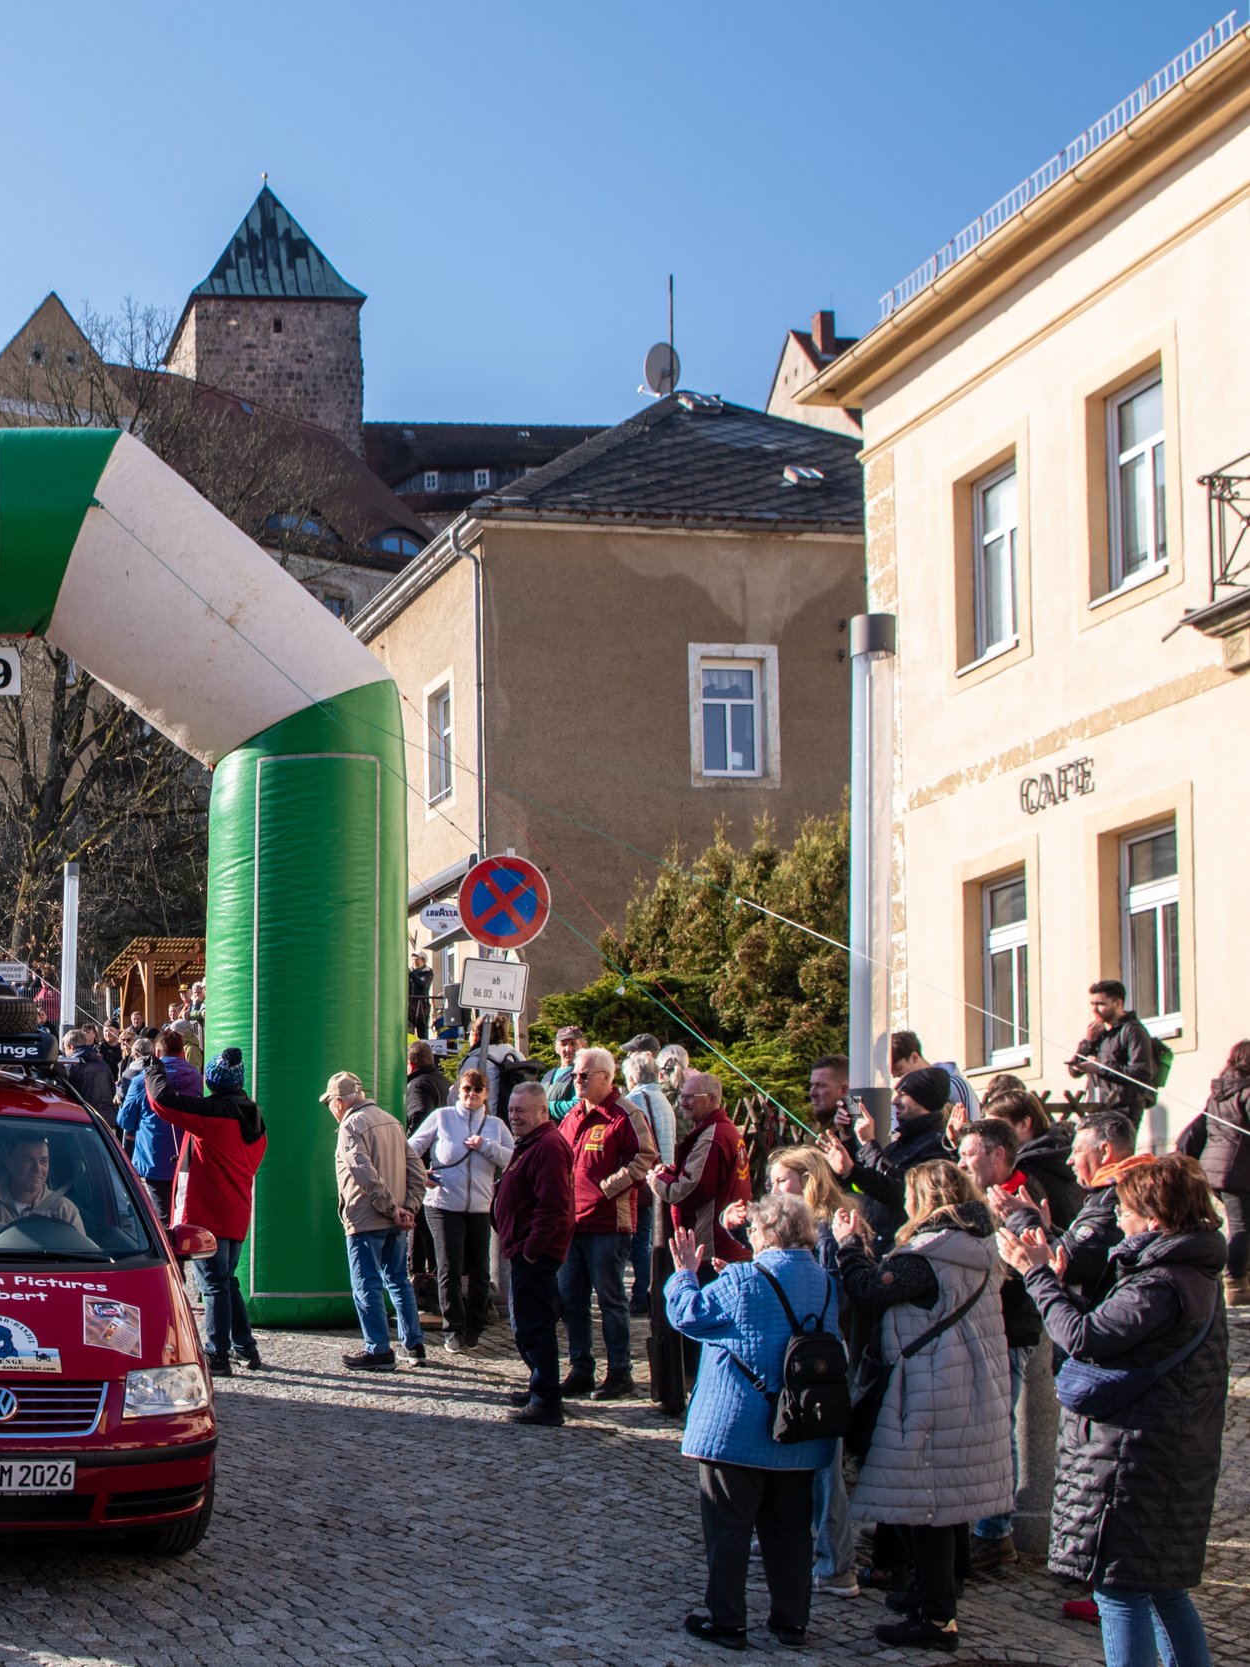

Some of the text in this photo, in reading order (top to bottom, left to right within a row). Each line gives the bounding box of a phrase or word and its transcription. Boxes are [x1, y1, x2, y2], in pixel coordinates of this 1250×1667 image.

[1019, 756, 1095, 815] CAFE
[426, 908, 458, 917] LAVAZZA
[491, 976, 501, 985] ab
[14, 1276, 108, 1292] Pictures
[18, 1464, 72, 1487] 2026
